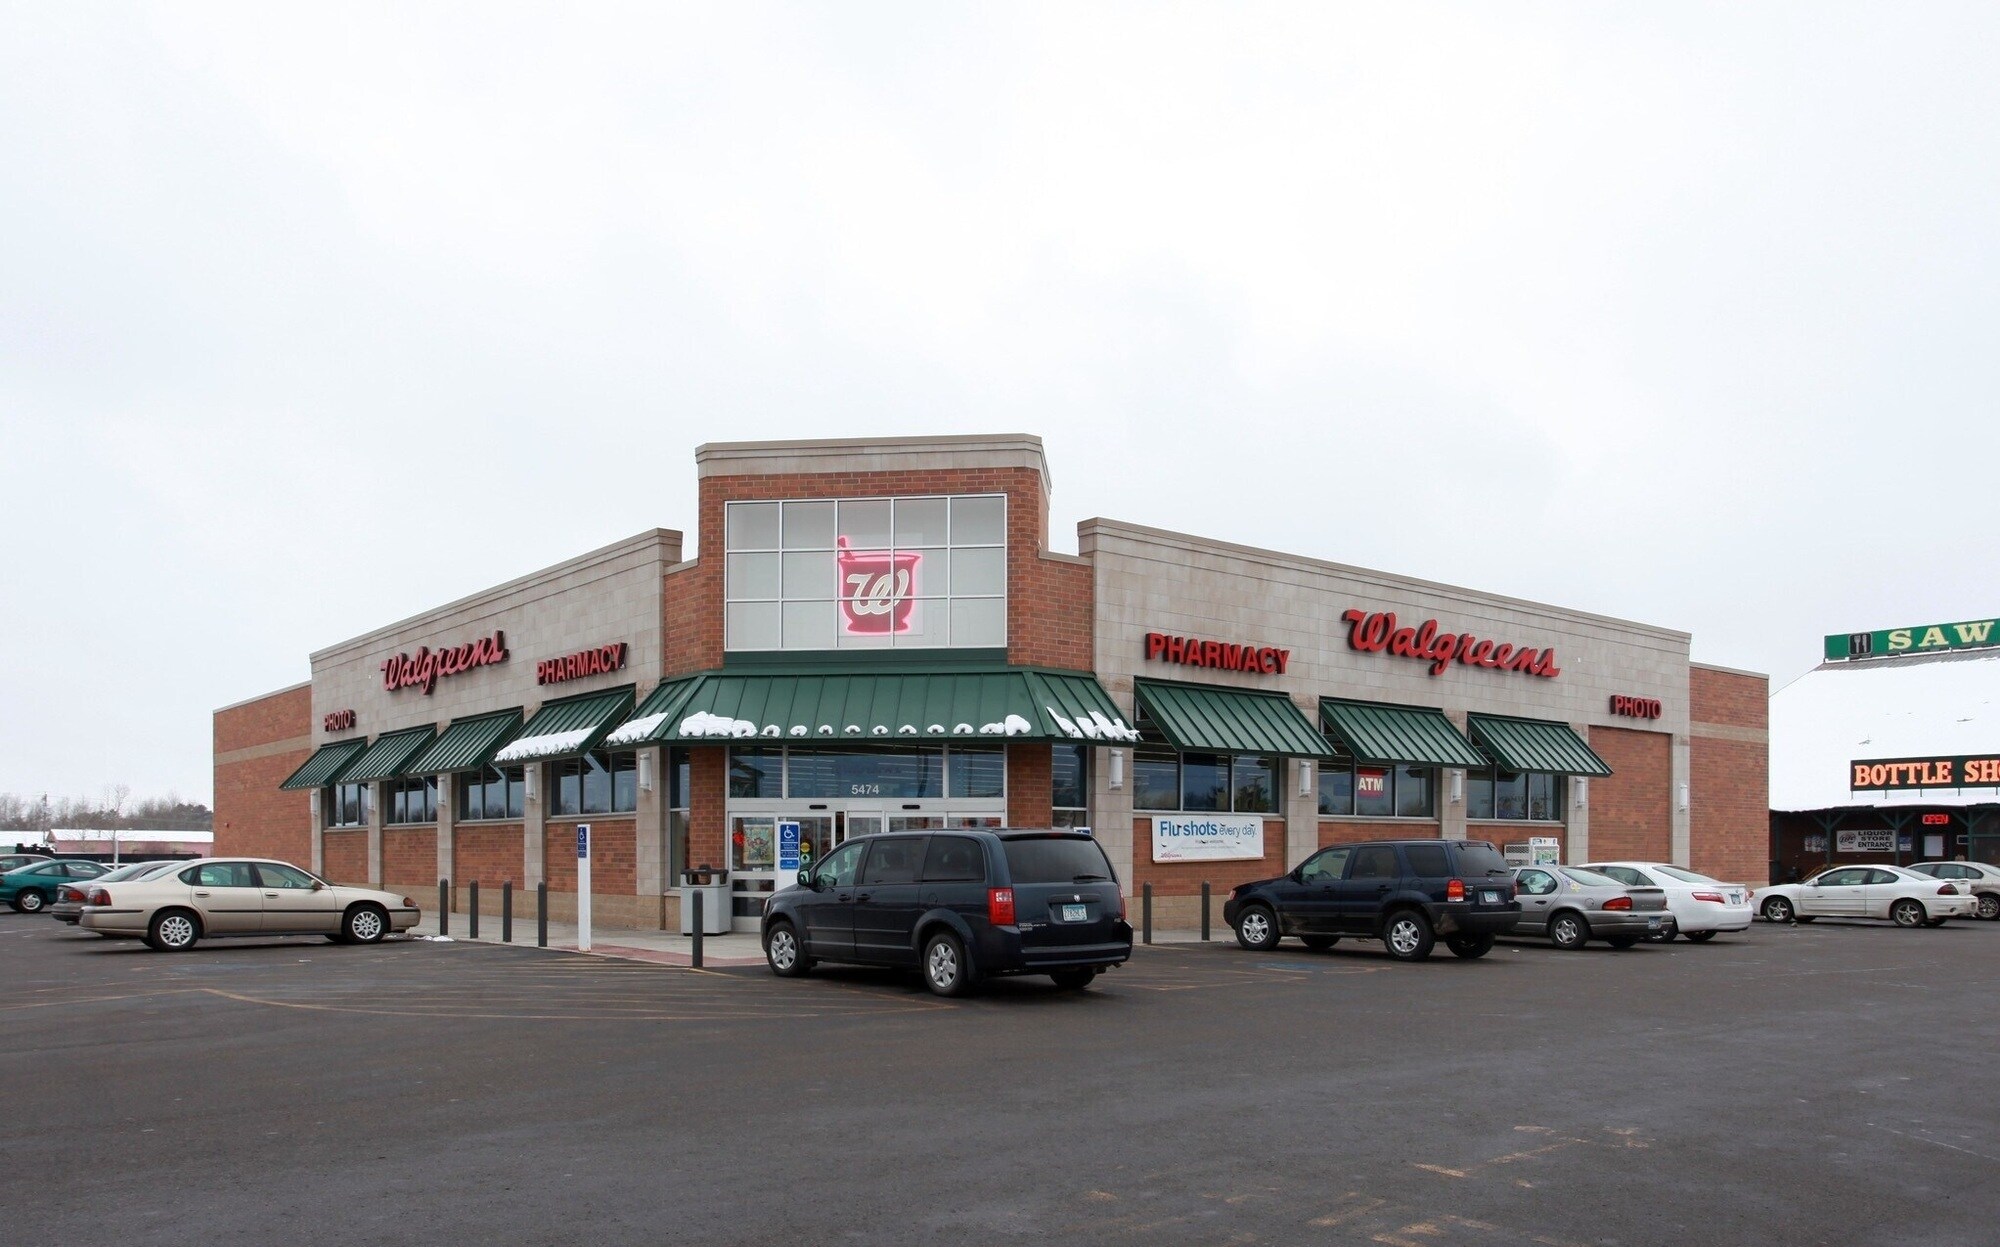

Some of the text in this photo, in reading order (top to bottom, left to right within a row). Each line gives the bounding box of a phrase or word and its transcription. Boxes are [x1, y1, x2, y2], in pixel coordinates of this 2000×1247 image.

[846, 568, 910, 616] W
[1342, 609, 1561, 677] Walgreens
[1888, 621, 1995, 651] SAW
[380, 630, 509, 695] Walgreens
[536, 642, 628, 686] PHARMACY
[1145, 632, 1291, 674] PHARMACY
[324, 710, 356, 731] PHOTO
[1611, 695, 1663, 720] PHOTO
[1358, 777, 1384, 792] ATM
[1854, 759, 2000, 787] BOTTLE SH
[851, 784, 880, 795] 5474
[1160, 821, 1180, 836] Flu
[1183, 821, 1218, 836] shots
[1219, 826, 1241, 838] every
[1924, 815, 1948, 823] OPEN
